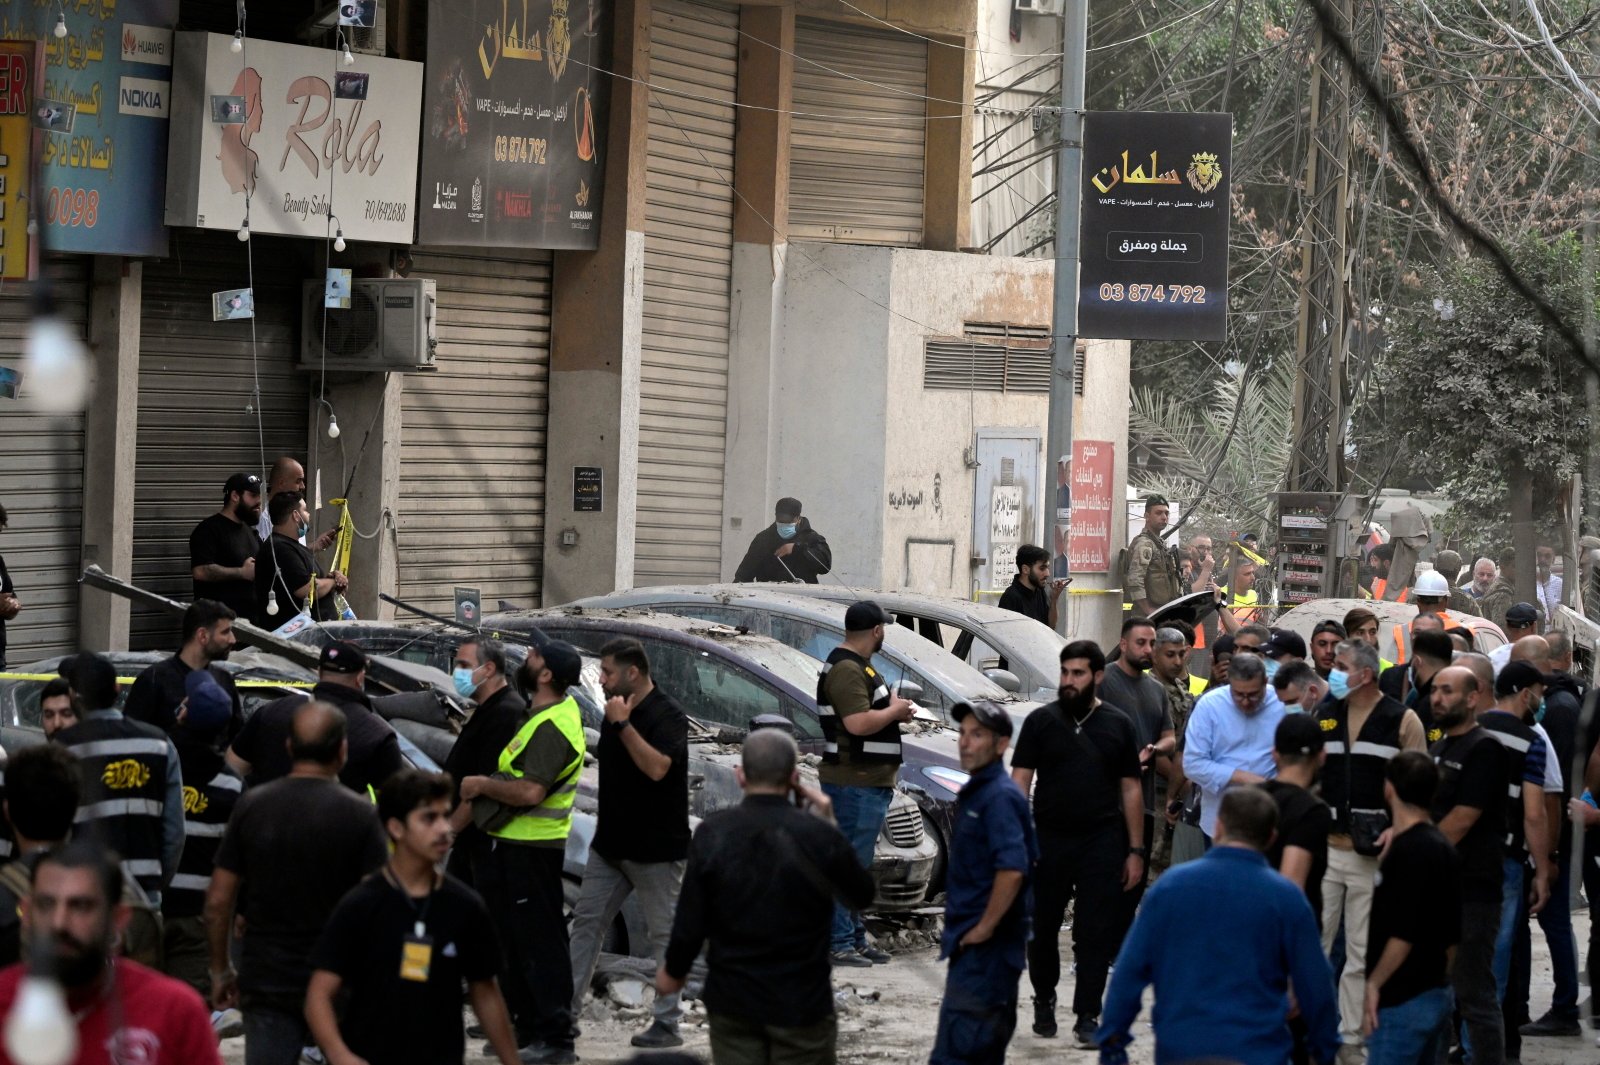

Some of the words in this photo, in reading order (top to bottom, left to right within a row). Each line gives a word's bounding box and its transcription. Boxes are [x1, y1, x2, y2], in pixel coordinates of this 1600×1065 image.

[138, 40, 165, 56] HUAWEI
[121, 88, 162, 110] NOKIA
[476, 98, 491, 112] VAPE
[494, 135, 508, 162] 03
[508, 136, 526, 163] 874
[528, 138, 547, 165] 792
[1091, 149, 1182, 194] سلمان
[283, 192, 310, 221] Beauty
[310, 194, 332, 216] Salon
[1118, 238, 1157, 254] ومفرق
[1160, 239, 1188, 254] جملة
[1099, 283, 1124, 302] 03
[1128, 283, 1165, 303] 874
[1169, 284, 1206, 304] 792
